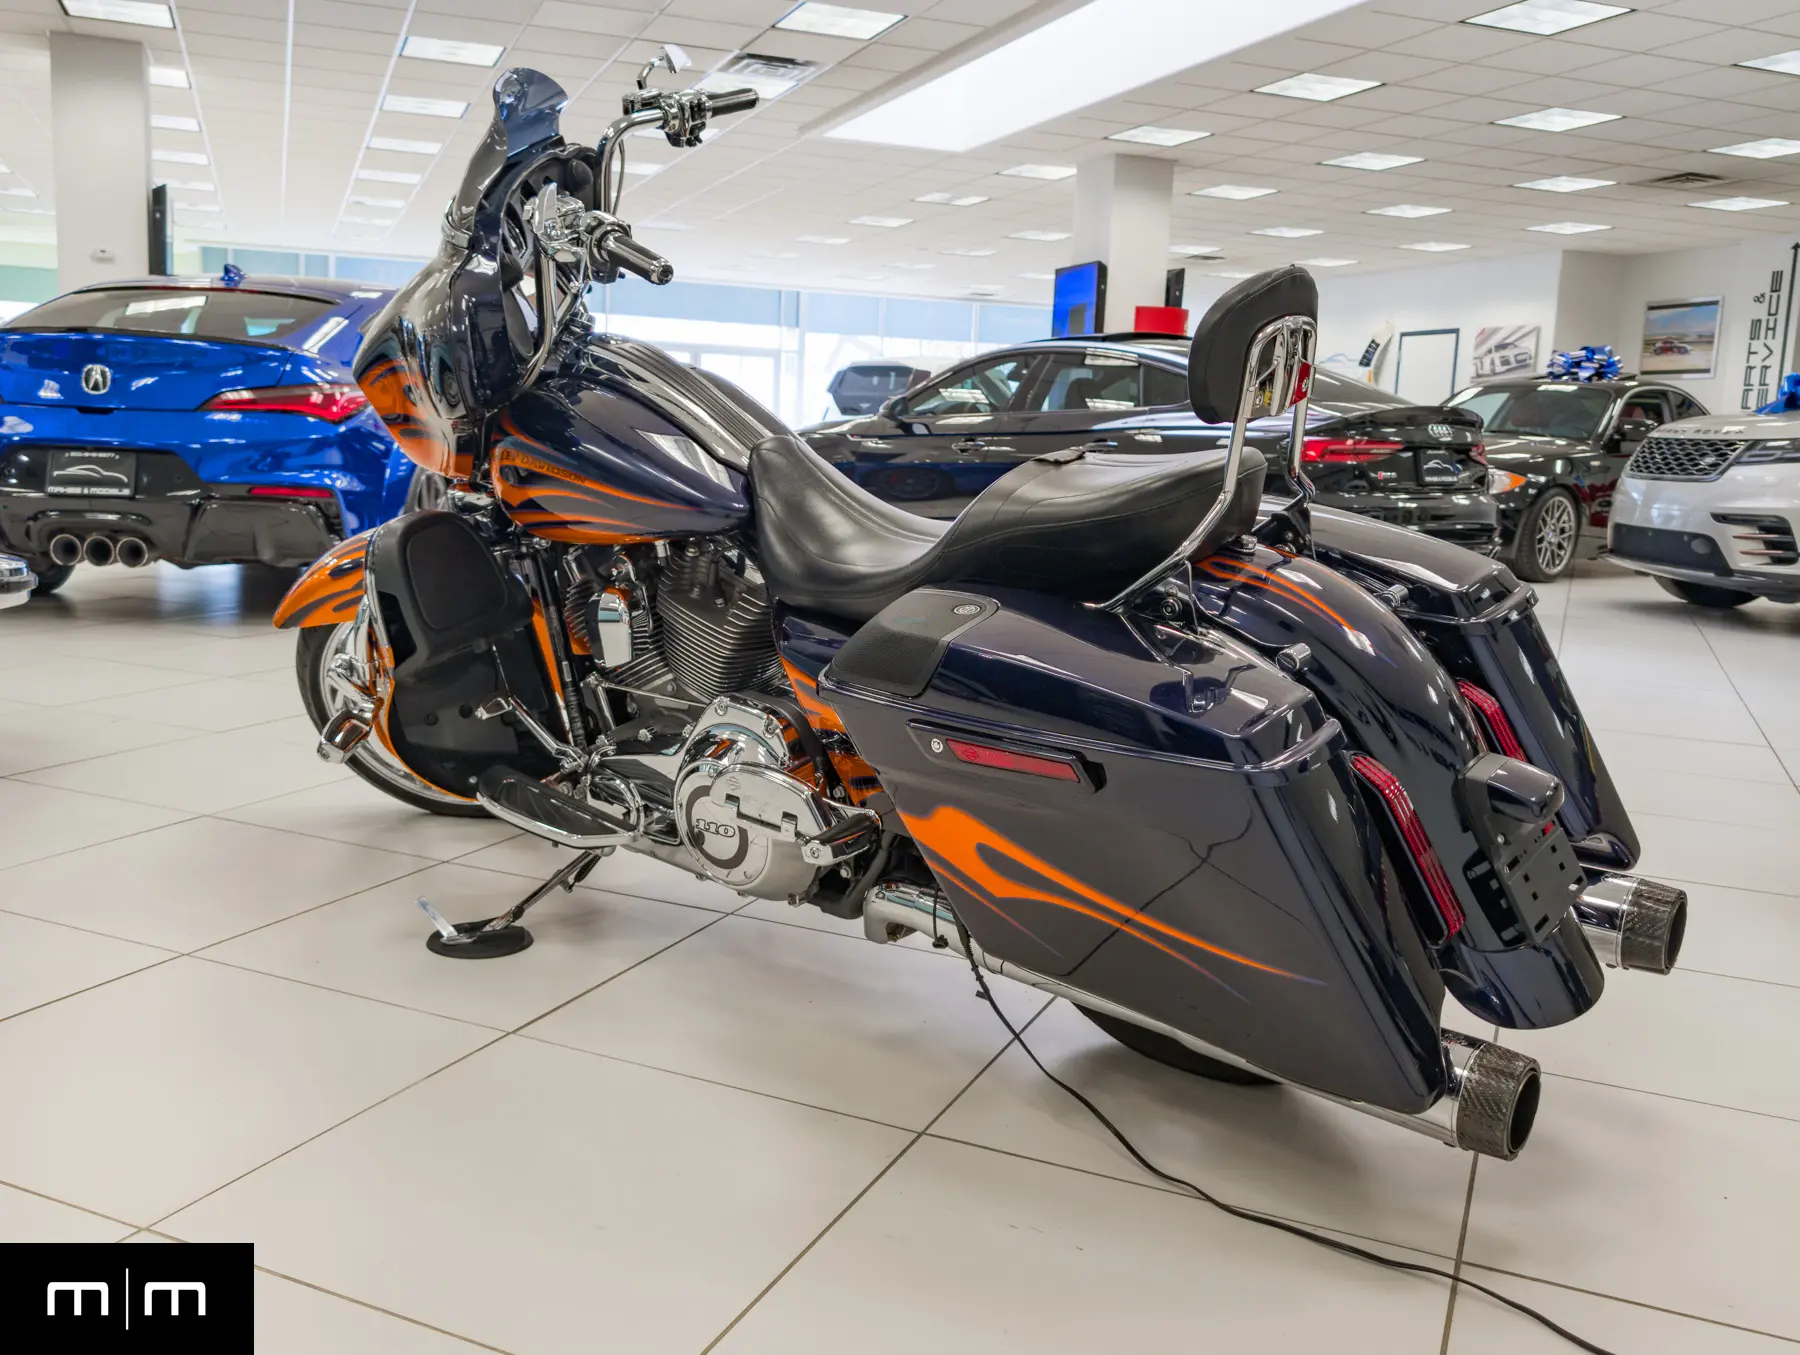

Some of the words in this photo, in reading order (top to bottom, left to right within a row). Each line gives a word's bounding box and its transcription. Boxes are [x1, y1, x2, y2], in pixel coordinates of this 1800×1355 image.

[1741, 318, 1762, 410] ARTS
[1753, 292, 1766, 304] &
[1756, 270, 1783, 409] ERVICE
[696, 818, 736, 838] 110
